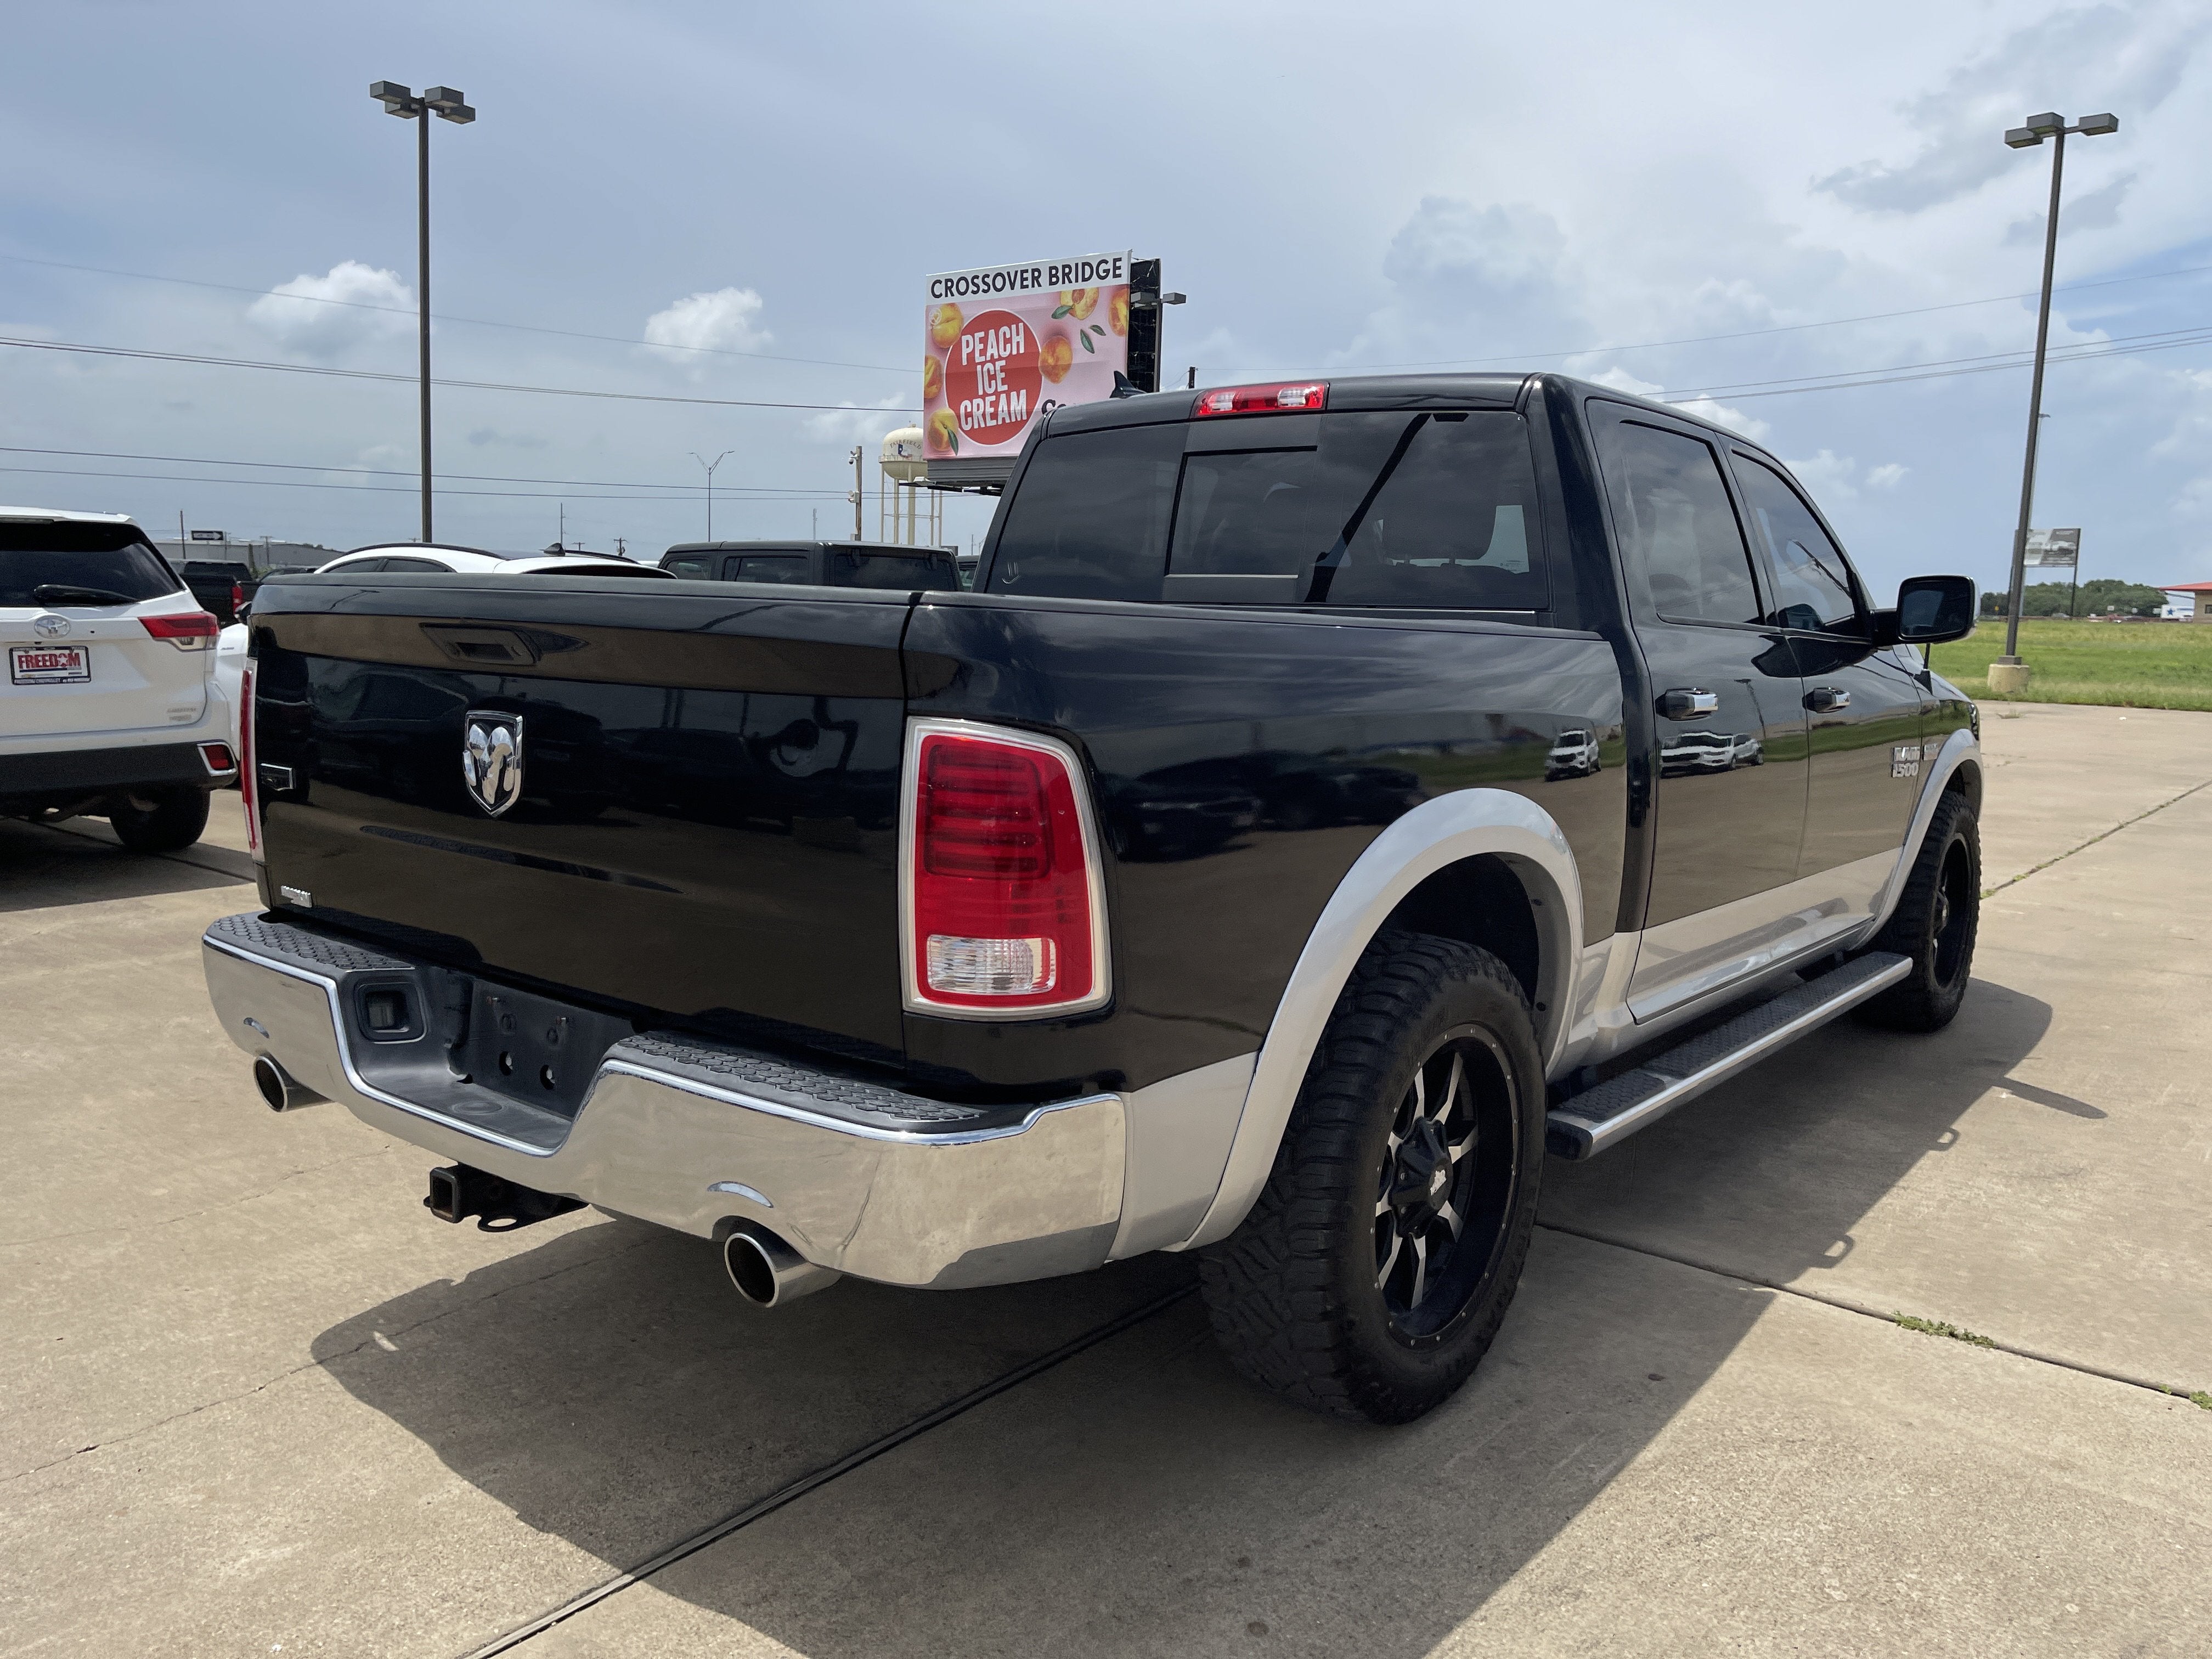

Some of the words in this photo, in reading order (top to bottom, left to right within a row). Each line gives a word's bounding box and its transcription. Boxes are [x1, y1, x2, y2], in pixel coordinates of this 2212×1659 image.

[930, 267, 1042, 299] CROSSOVER
[1048, 257, 1122, 286] BRIDGE
[961, 322, 1025, 366] PEACH
[977, 359, 1008, 396] ICE
[960, 389, 1028, 431] CREAM
[890, 439, 922, 449] FAIRFIELD
[17, 652, 81, 669] FREEDOM
[1892, 762, 1919, 778] 1500
